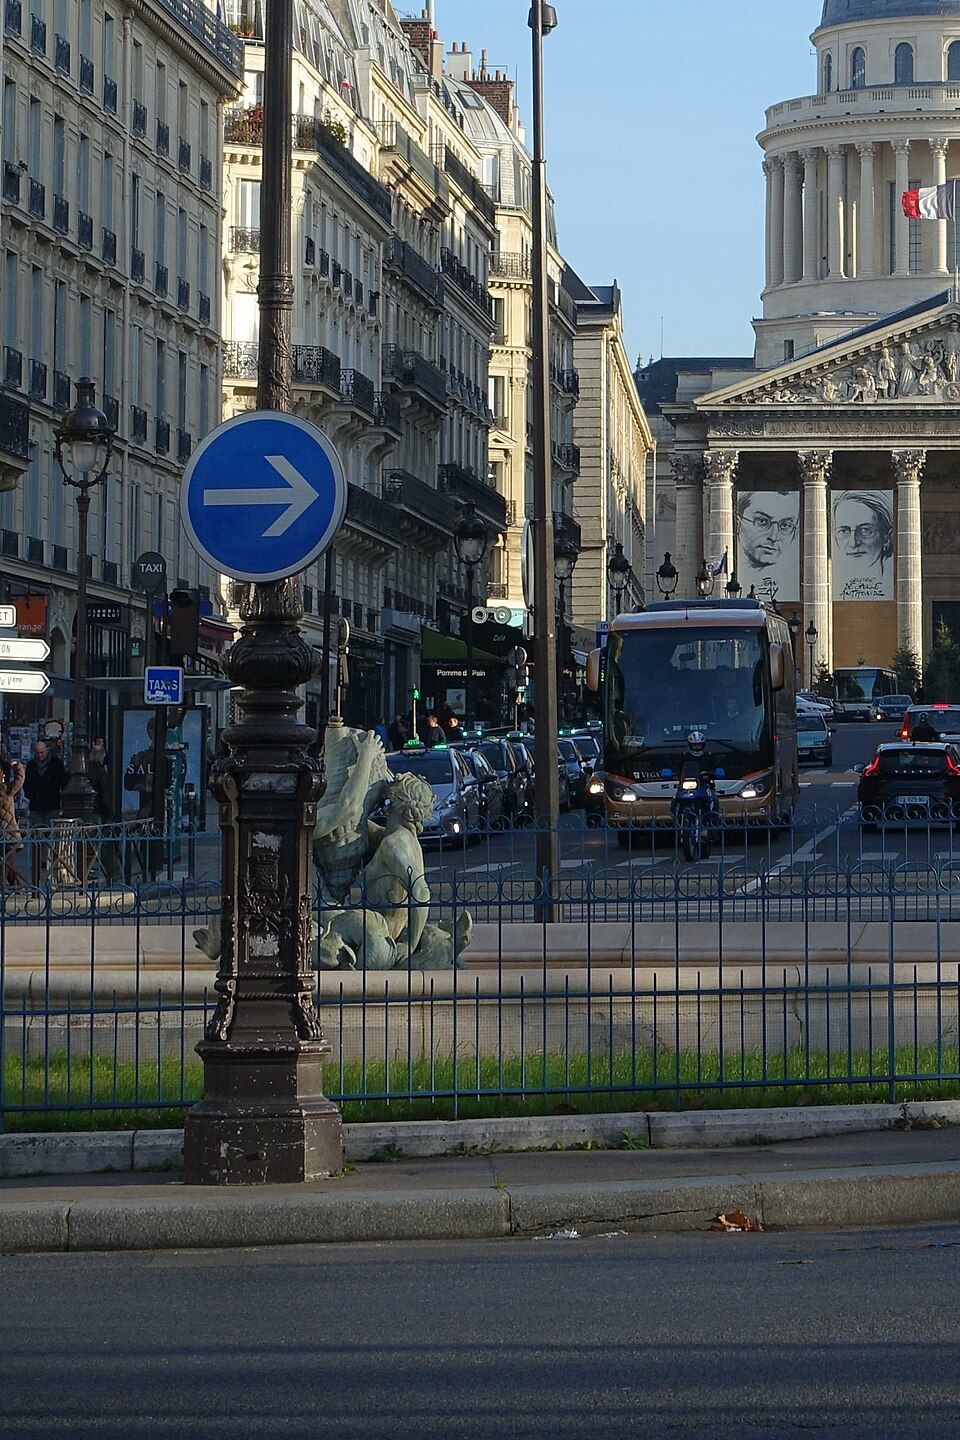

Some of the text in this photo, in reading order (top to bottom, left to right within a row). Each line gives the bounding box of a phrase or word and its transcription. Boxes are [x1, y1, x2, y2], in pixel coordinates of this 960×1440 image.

[139, 563, 163, 573] TAXI
[18, 623, 42, 632] range
[436, 669, 462, 677] Pomme
[471, 669, 486, 677] Pain
